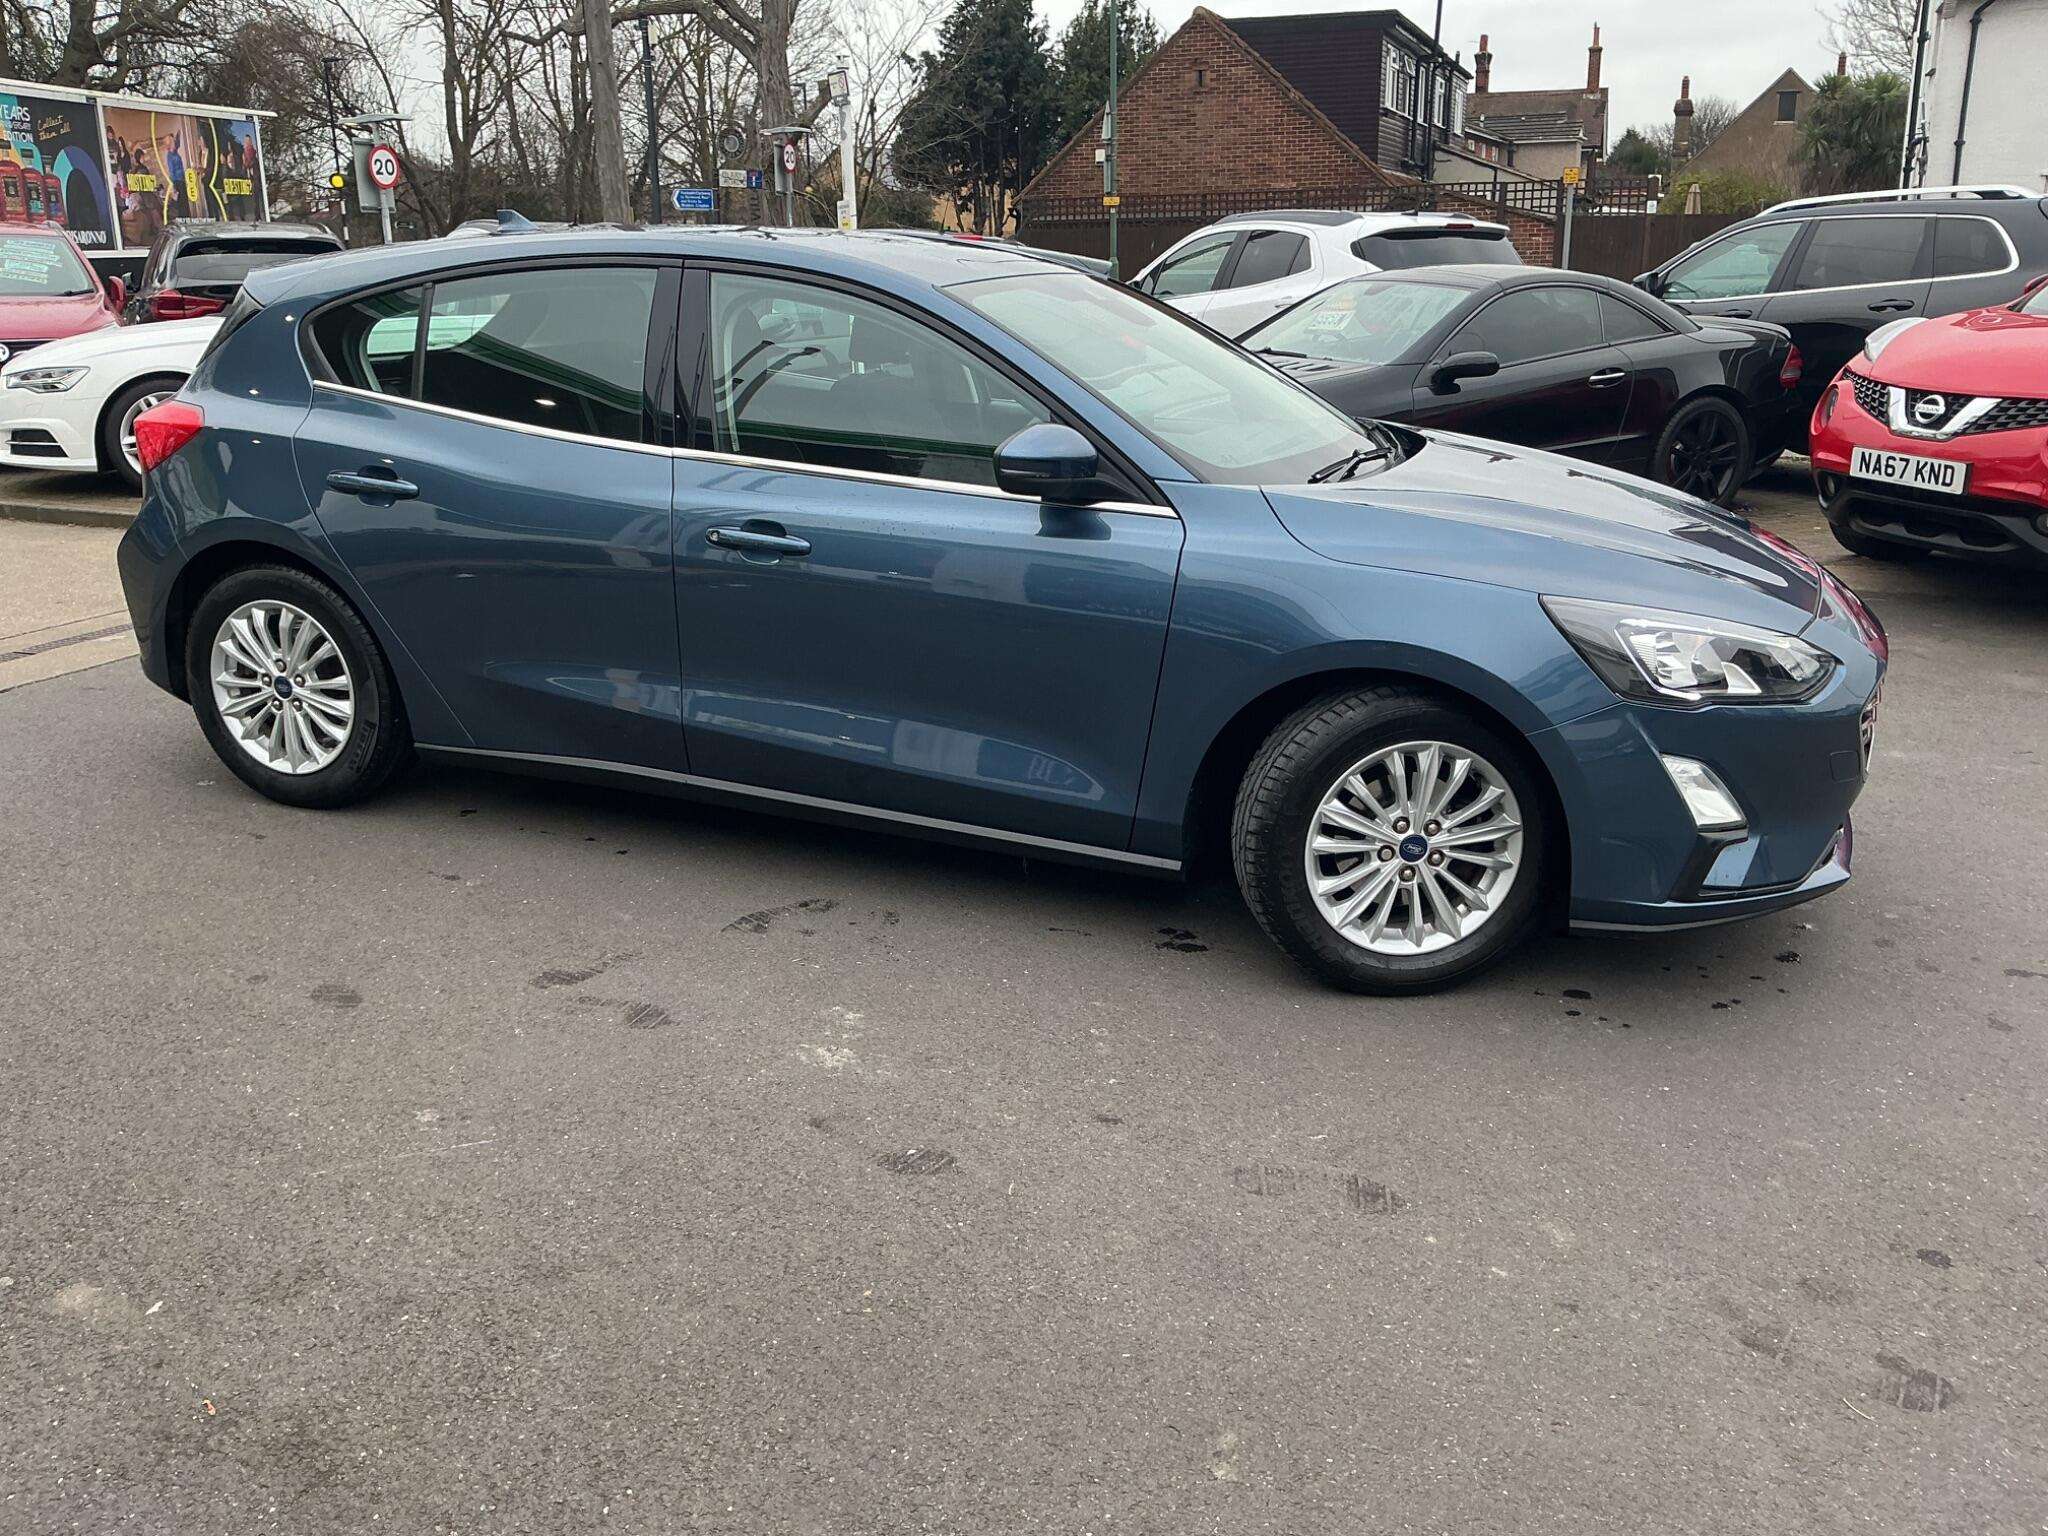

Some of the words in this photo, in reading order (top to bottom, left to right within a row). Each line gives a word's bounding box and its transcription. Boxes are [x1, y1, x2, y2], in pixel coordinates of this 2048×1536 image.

[3, 130, 34, 143] EDITION
[785, 150, 795, 164] 20
[374, 159, 395, 176] 20
[1859, 451, 1910, 479] NA67
[1914, 459, 1955, 487] KND
